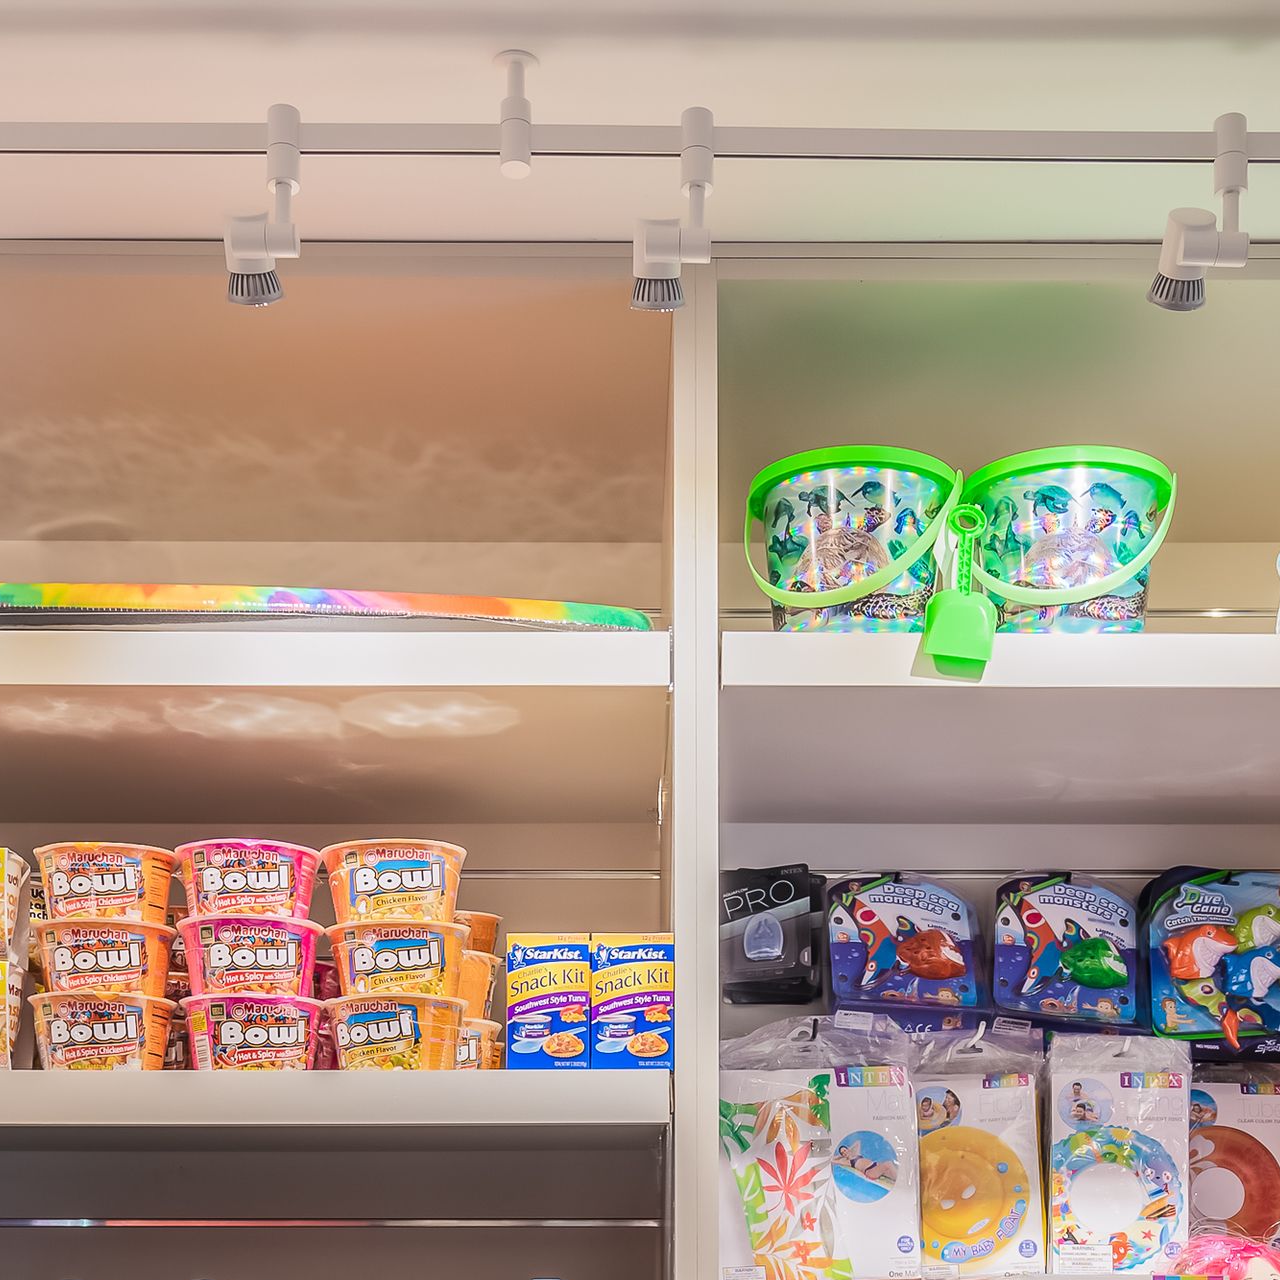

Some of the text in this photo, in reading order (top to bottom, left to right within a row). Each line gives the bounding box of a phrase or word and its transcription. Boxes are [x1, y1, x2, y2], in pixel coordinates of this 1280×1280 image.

[68, 852, 123, 864] Maruchan
[376, 849, 431, 861] Maruchan
[52, 867, 137, 896] Bowl
[203, 862, 288, 892] Bowl
[355, 863, 441, 894] Bowl
[376, 894, 429, 907] Chicken Flavor
[724, 879, 795, 920] PRO
[869, 893, 944, 915] monsters
[883, 883, 960, 911] Deep sea
[1039, 894, 1112, 921] monsters
[1054, 884, 1128, 918] Deep sea
[1183, 885, 1222, 906] Dive
[1192, 902, 1230, 916] Game
[71, 928, 128, 940] Maruchan
[232, 926, 287, 938] Maruchan
[373, 928, 429, 939] Maruchan
[53, 943, 140, 972] Bowl
[210, 943, 296, 969] Bowl
[354, 939, 439, 972] Bowl
[373, 972, 426, 986] Chicken Flavor
[510, 968, 585, 997] Snack Kit
[595, 968, 669, 997] Snack Kit
[513, 994, 587, 1014] Southwest Style Tuna
[337, 1010, 414, 1047] Bowl
[838, 1068, 906, 1087] INTEX
[953, 1209, 1021, 1258] MY BABY FLOAT
